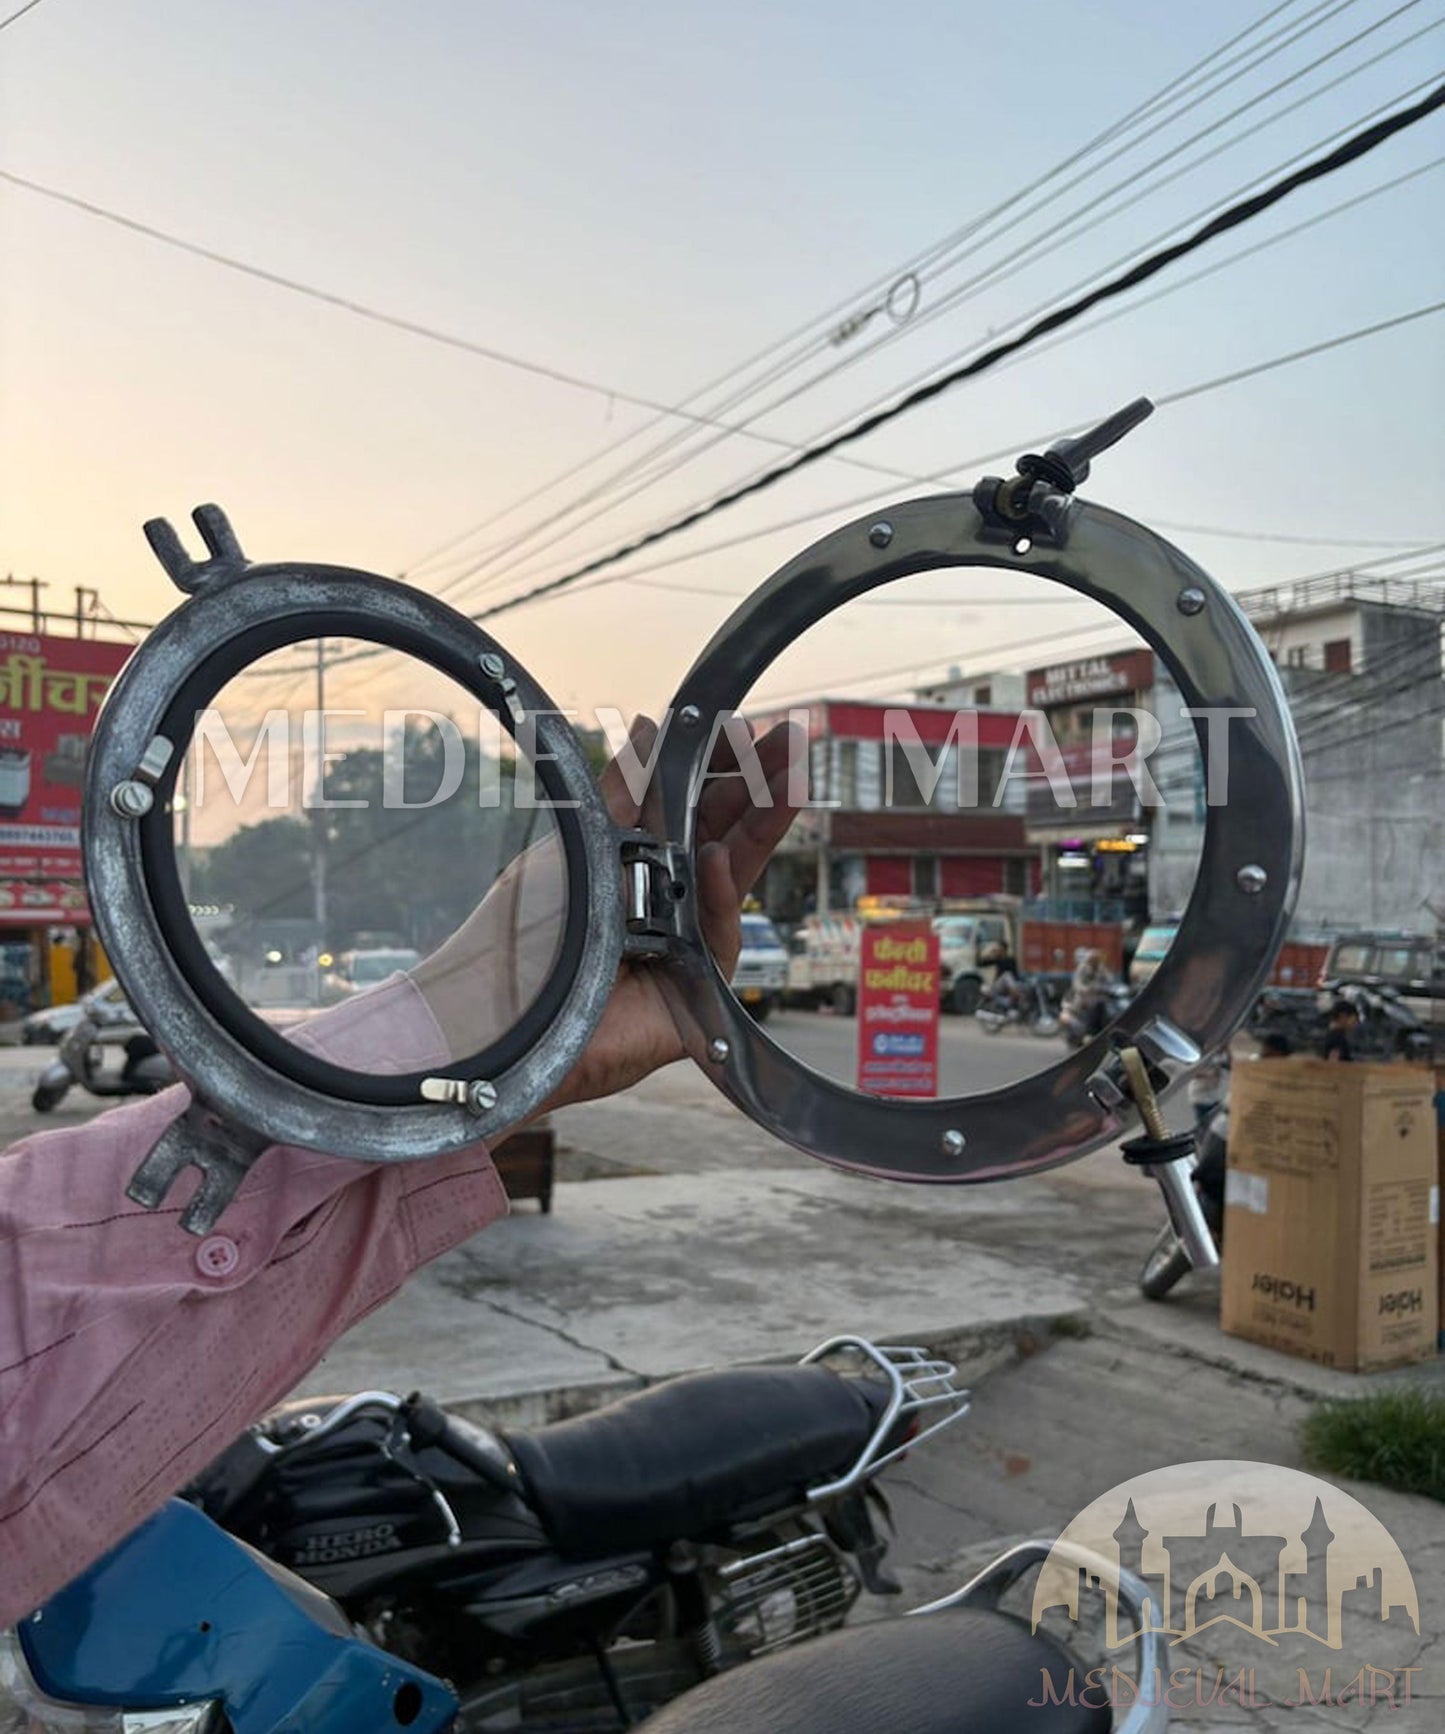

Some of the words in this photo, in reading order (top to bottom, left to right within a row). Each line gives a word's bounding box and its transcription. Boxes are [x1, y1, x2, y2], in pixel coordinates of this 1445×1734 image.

[1045, 658, 1112, 684] MITTAL
[1032, 671, 1128, 706] ELECTRONICS
[1251, 1272, 1317, 1312] Haier
[1378, 1287, 1423, 1315] Haier
[295, 1535, 403, 1564] HONDA
[306, 1524, 395, 1550] HERO
